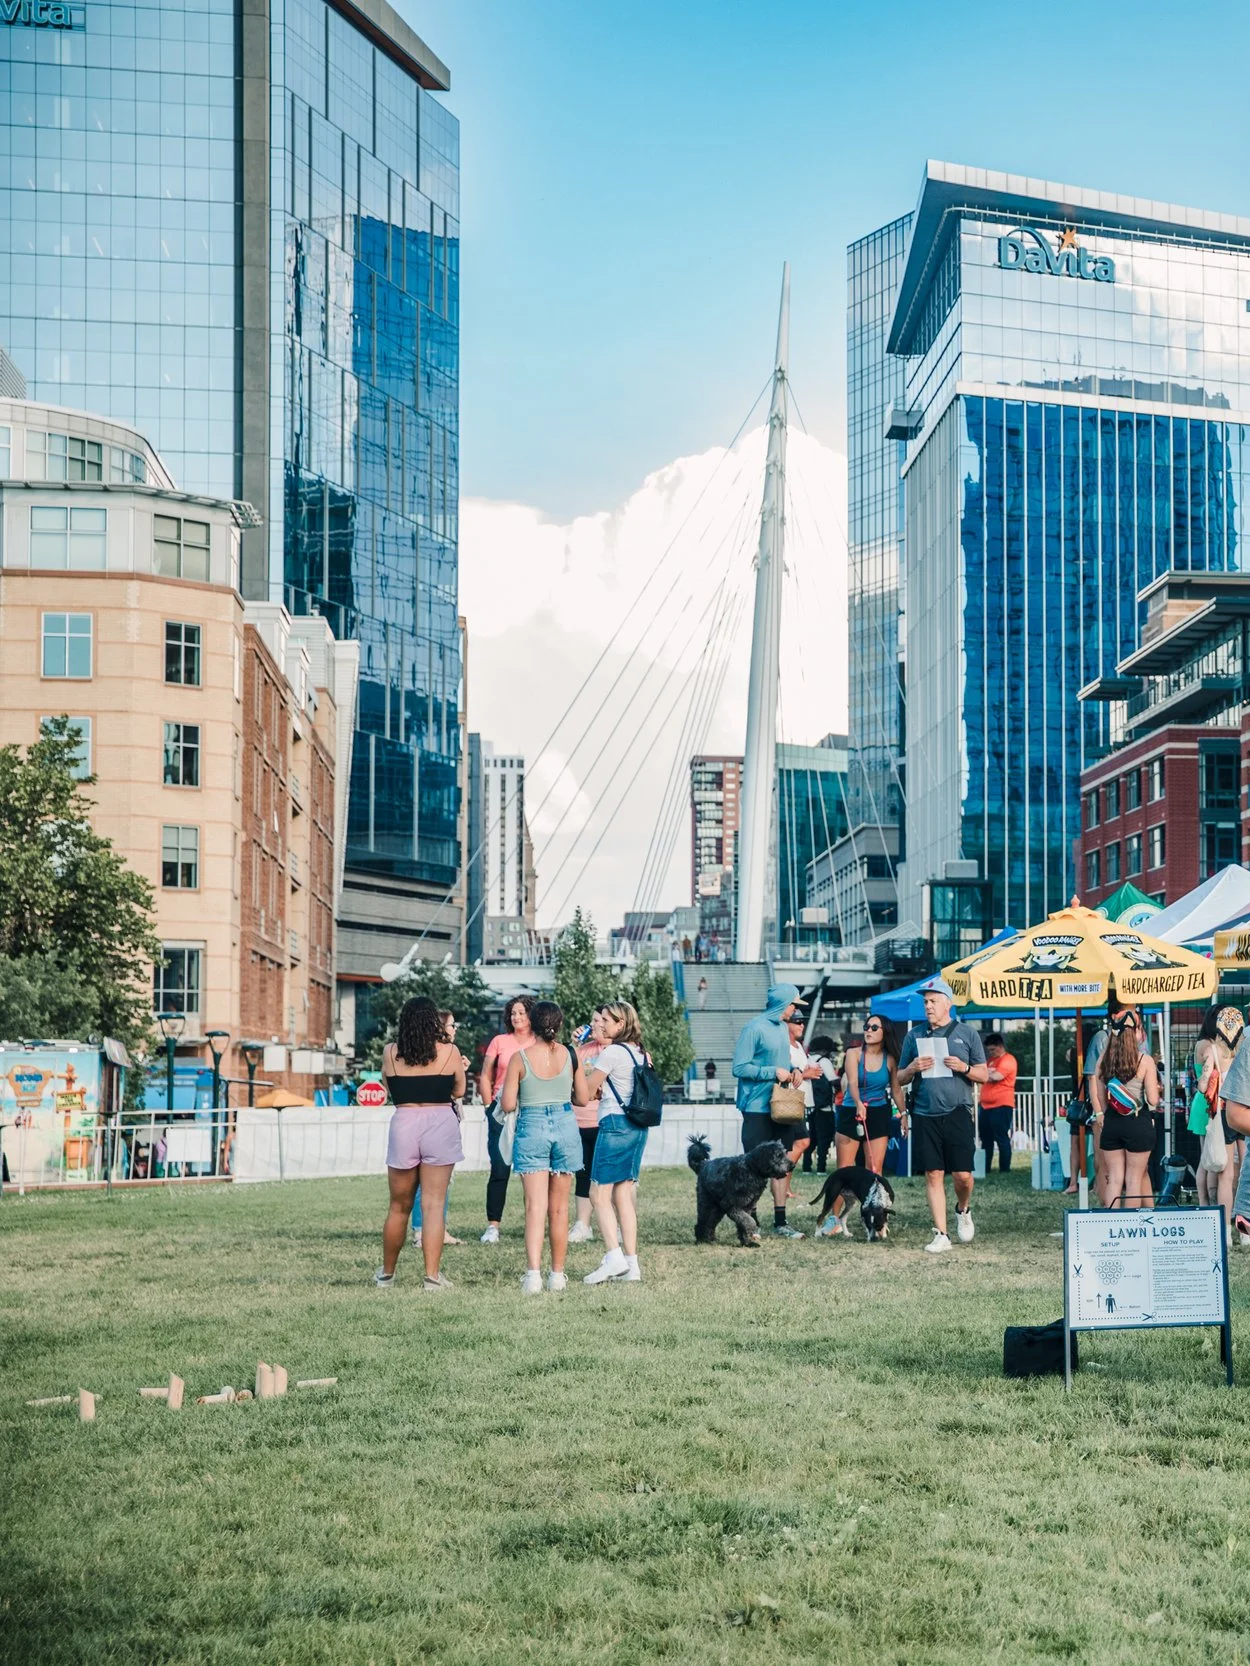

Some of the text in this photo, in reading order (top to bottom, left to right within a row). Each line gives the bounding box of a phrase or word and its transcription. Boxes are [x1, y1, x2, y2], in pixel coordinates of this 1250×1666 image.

[1033, 936, 1059, 946] VOODOO
[979, 977, 1053, 1002] HARD TEA
[1059, 983, 1100, 993] WITH MORE BITE
[1121, 972, 1206, 995] HARDCHARGED TEA
[358, 1089, 386, 1102] STOP
[1109, 1226, 1186, 1239] LAWN LOGS
